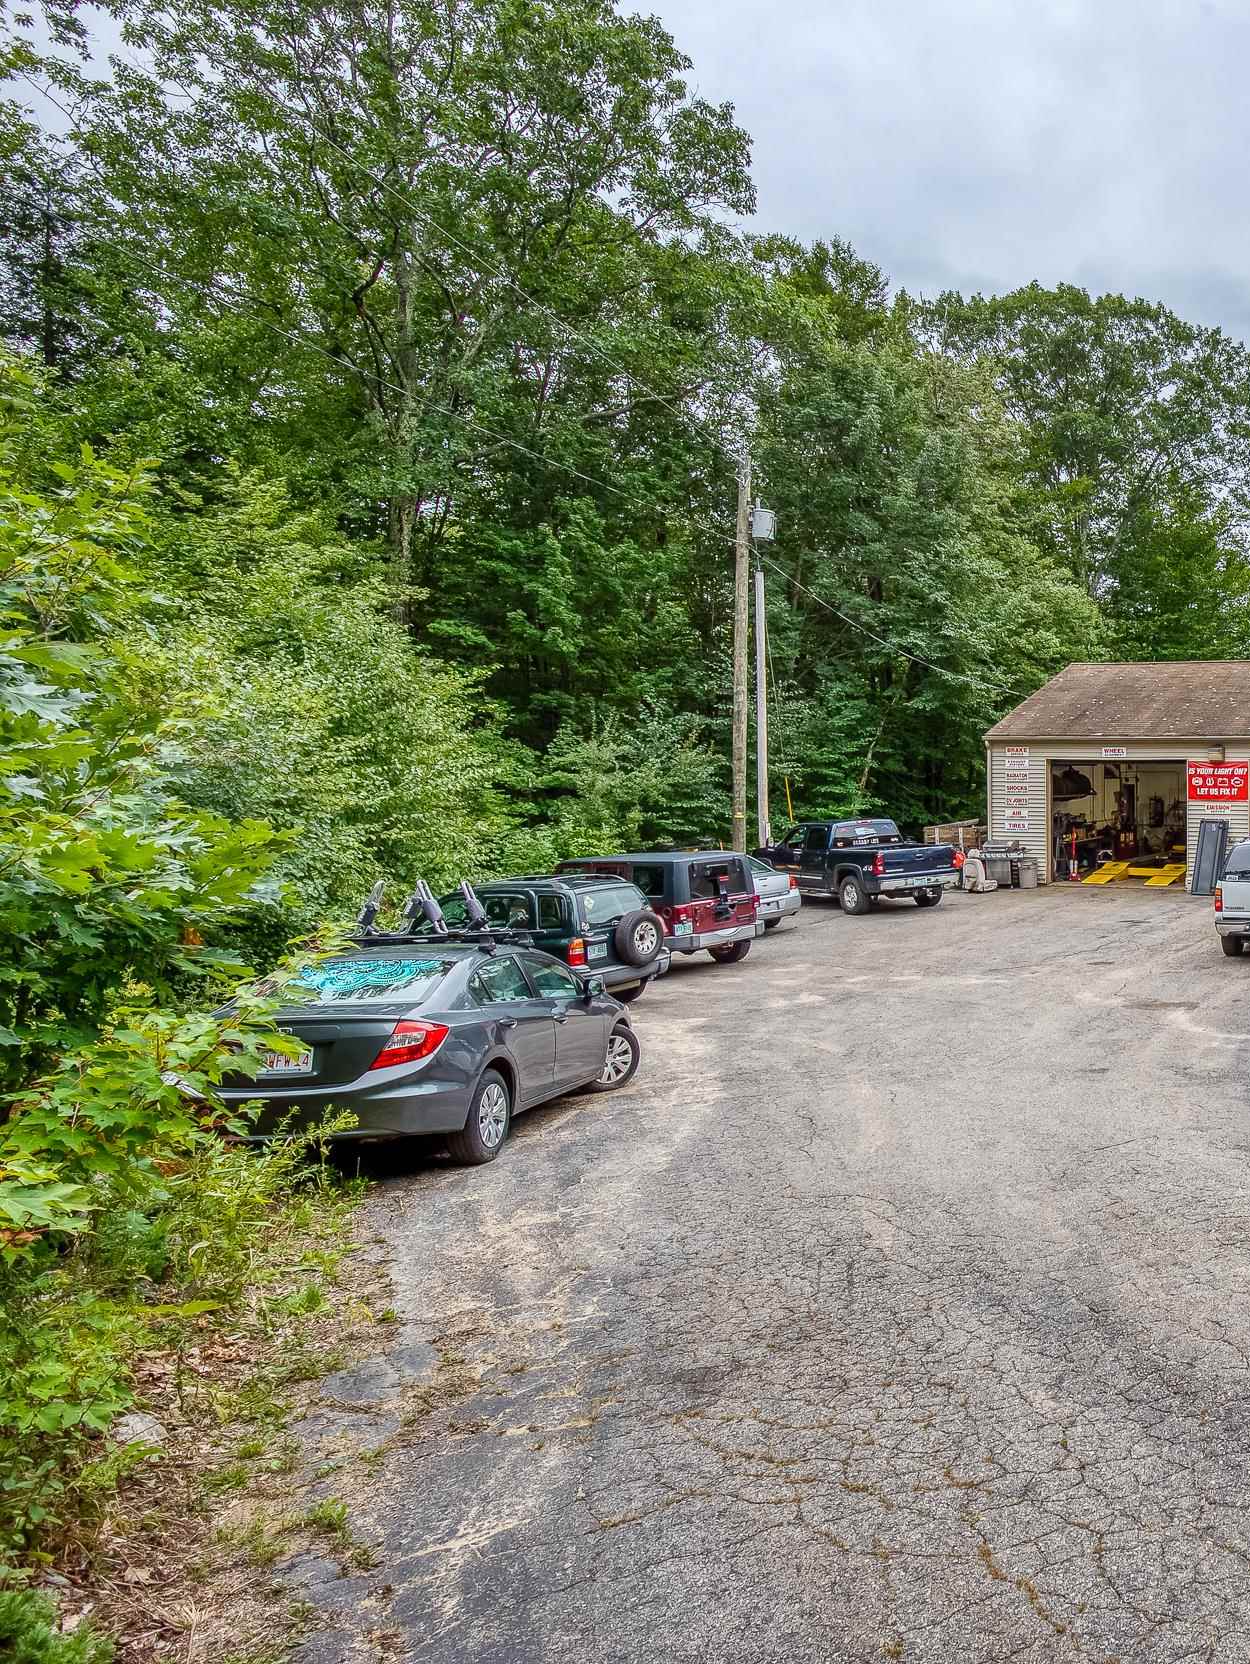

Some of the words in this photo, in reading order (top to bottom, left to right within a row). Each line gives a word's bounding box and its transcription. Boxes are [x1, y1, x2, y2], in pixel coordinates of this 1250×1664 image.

[1233, 767, 1248, 775] ON?
[1196, 788, 1209, 796] LET
[1209, 788, 1219, 796] US
[1220, 788, 1231, 796] FIX
[1231, 788, 1239, 797] IT
